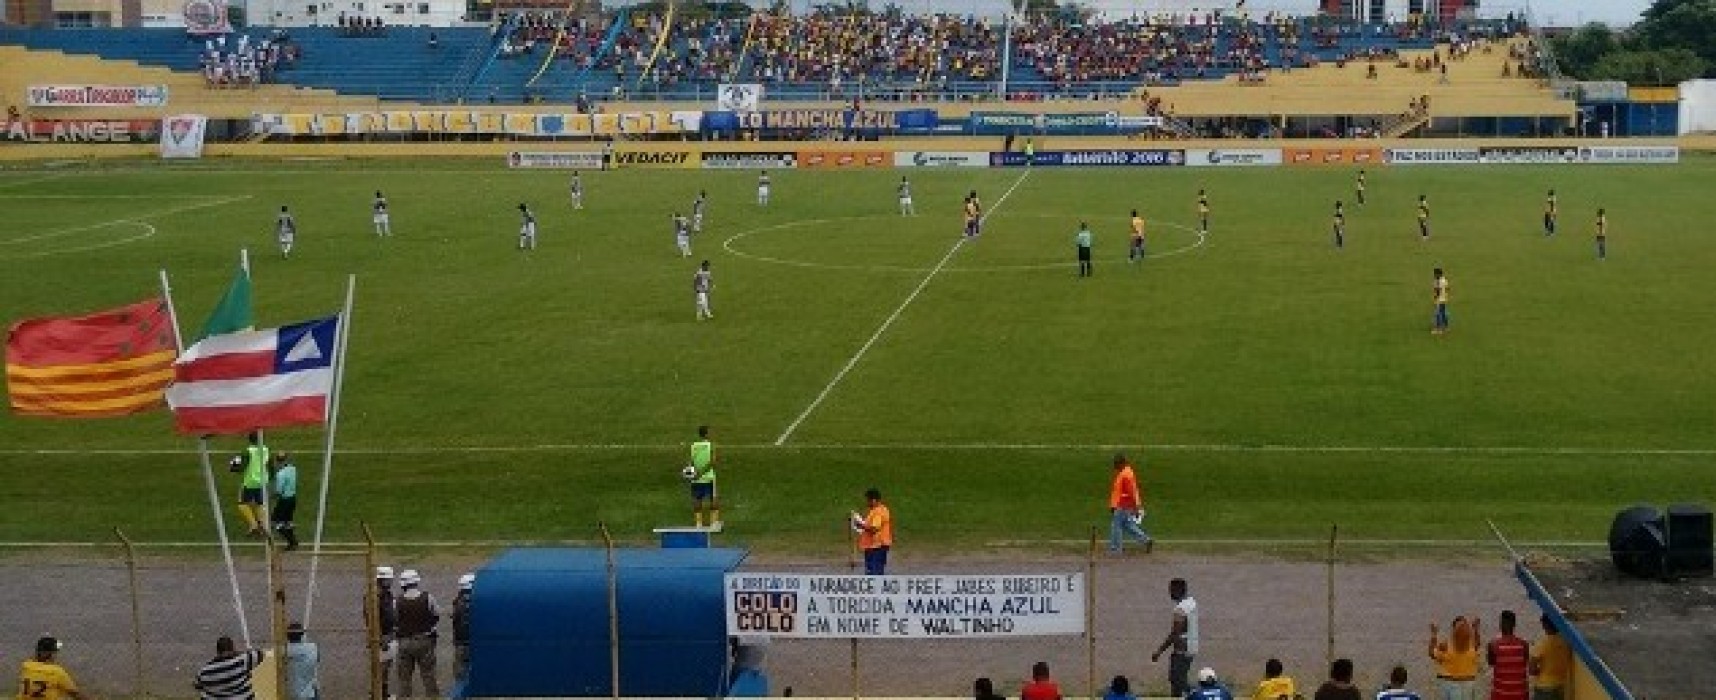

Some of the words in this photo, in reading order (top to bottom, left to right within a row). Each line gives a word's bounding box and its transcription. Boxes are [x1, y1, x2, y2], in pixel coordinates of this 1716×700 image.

[768, 111, 844, 127] MANCHA
[615, 152, 690, 163] VEDACIT
[810, 577, 874, 594] AGRADECE
[881, 578, 900, 594] AO
[951, 578, 995, 594] JABES
[1002, 577, 1061, 594] RIBEIRO
[737, 593, 796, 611] COLO
[808, 597, 818, 613] A
[827, 597, 895, 613] TORCIDA
[905, 597, 992, 615] MANCHA
[1000, 597, 1060, 615] AZUL
[737, 613, 794, 632] COLO
[807, 616, 830, 633] EM
[837, 617, 881, 635] NOME
[889, 618, 908, 635] DE
[921, 616, 1014, 635] WALTINHO
[23, 678, 47, 697] 12
